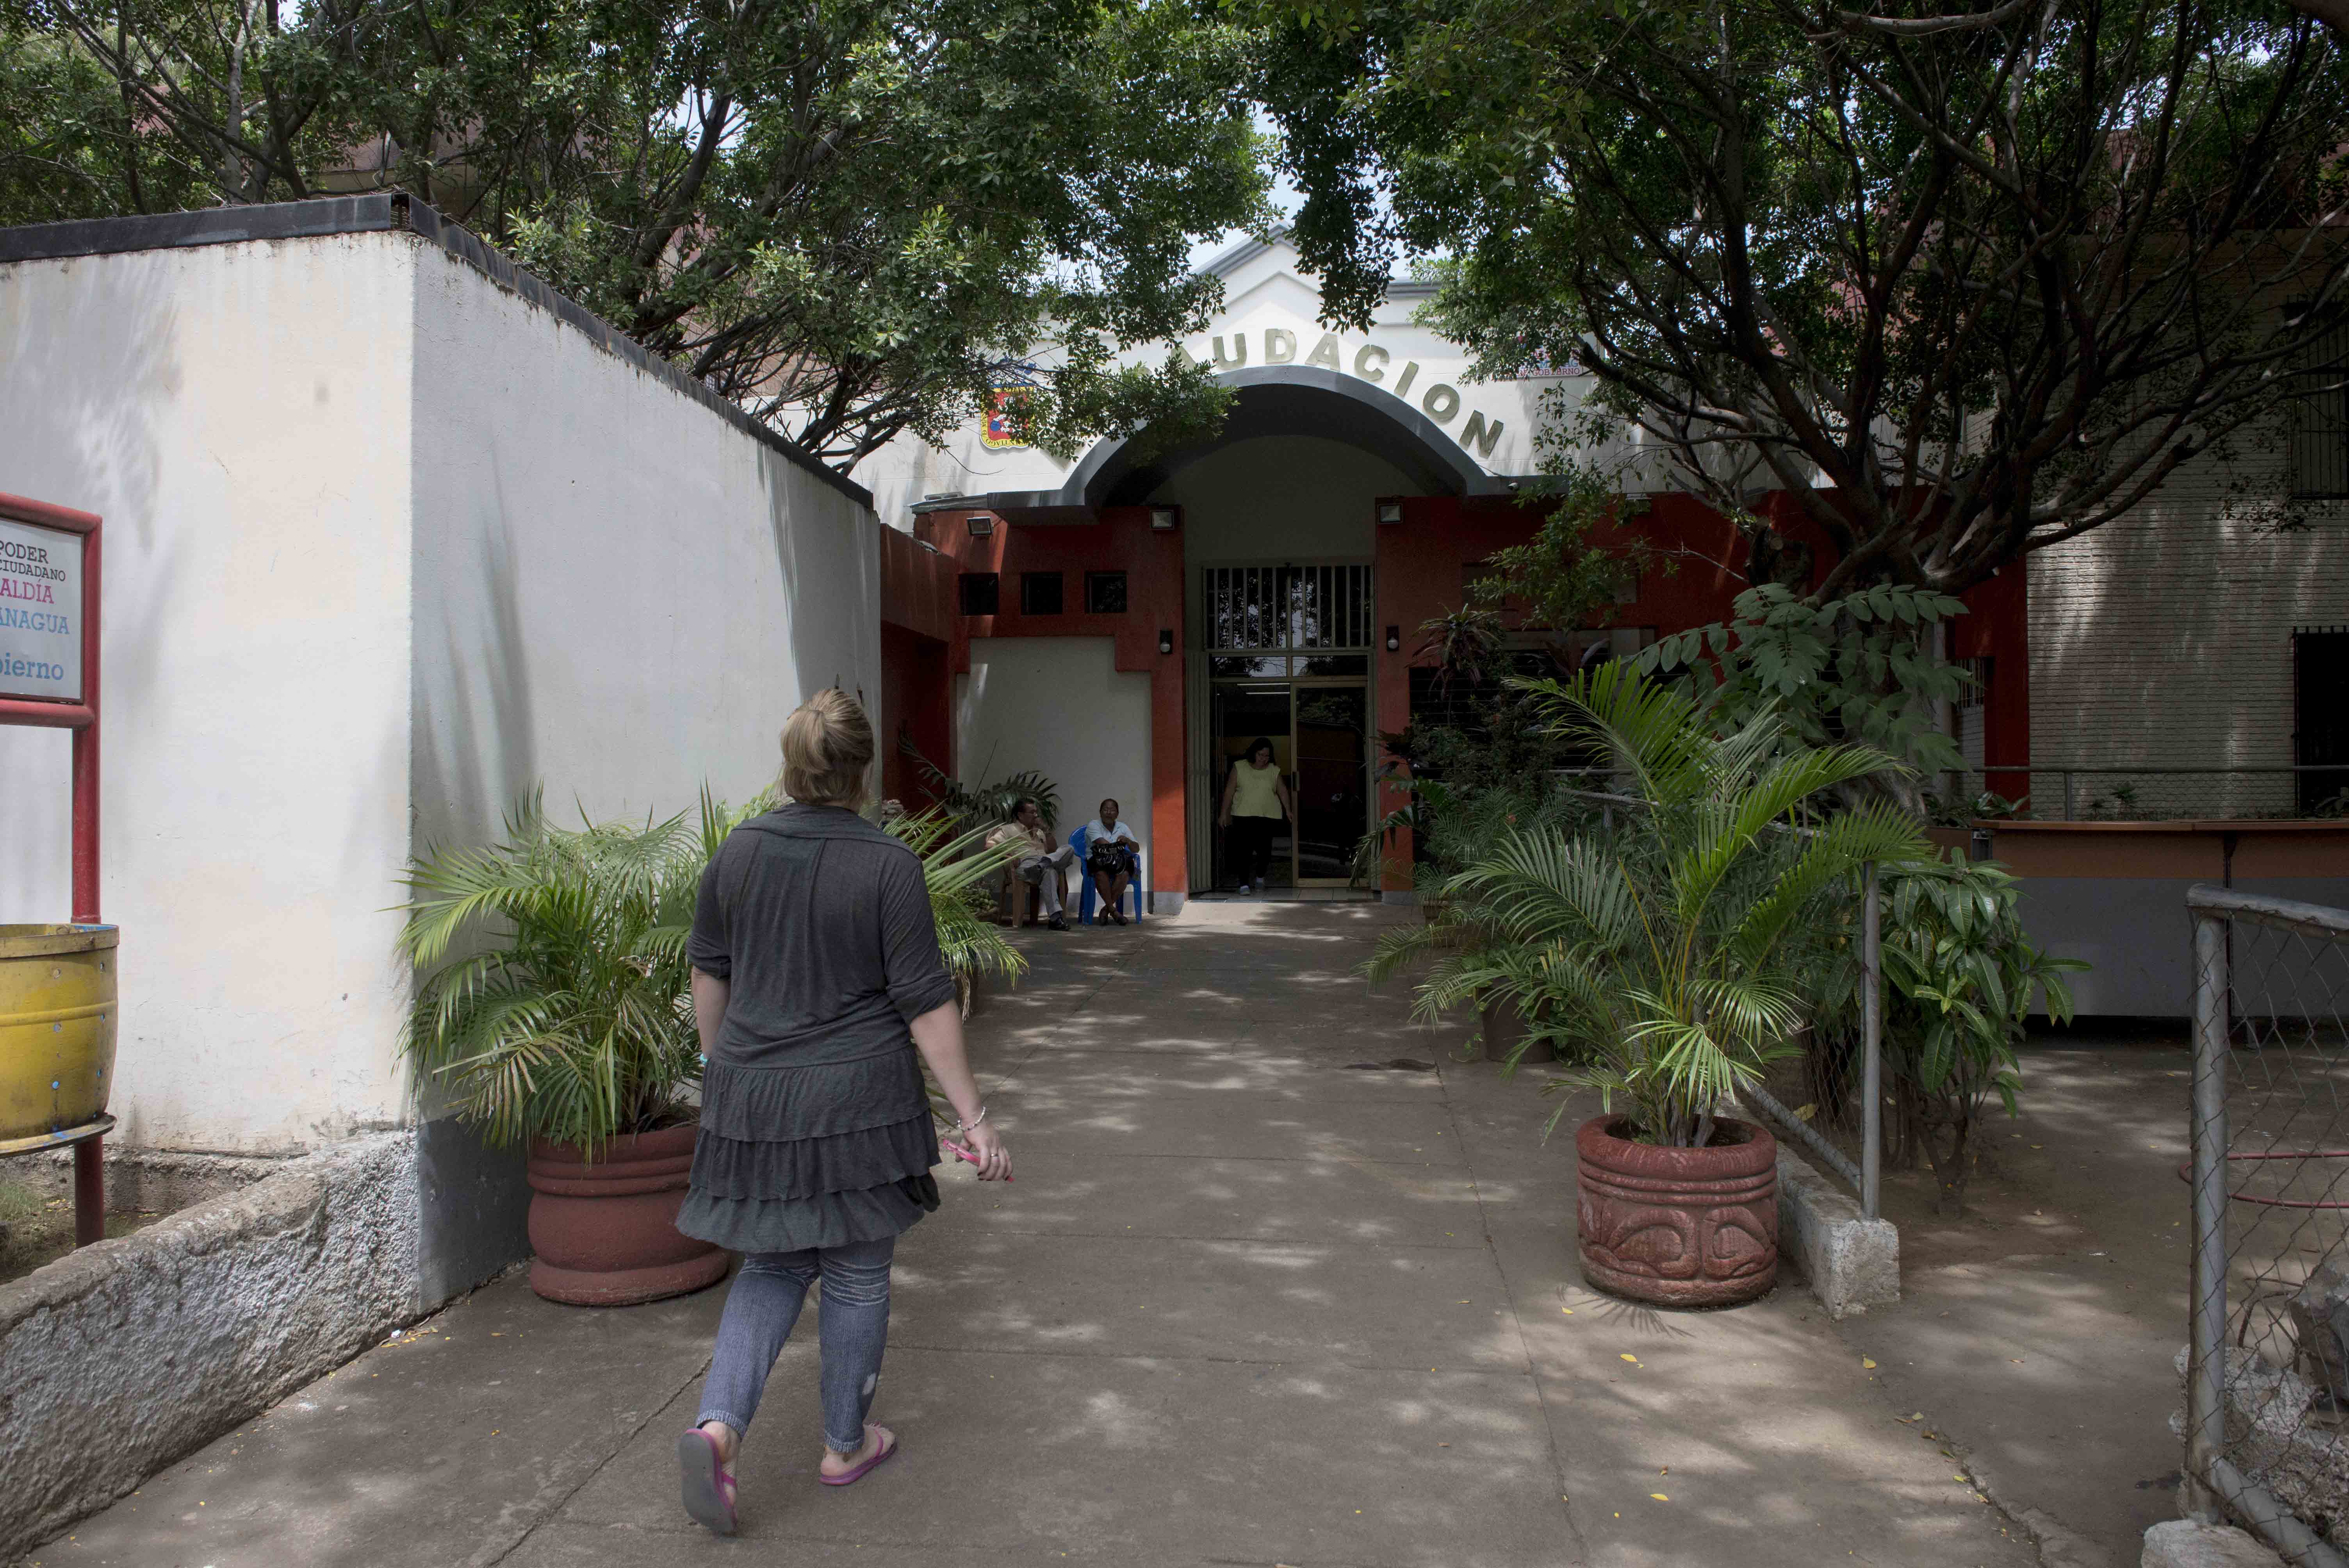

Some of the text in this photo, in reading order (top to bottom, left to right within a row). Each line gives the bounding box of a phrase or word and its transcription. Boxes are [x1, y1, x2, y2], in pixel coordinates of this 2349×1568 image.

[1039, 328, 1504, 472] UDACION
[0, 578, 55, 604] ALDÍA
[0, 652, 64, 681] ierno
